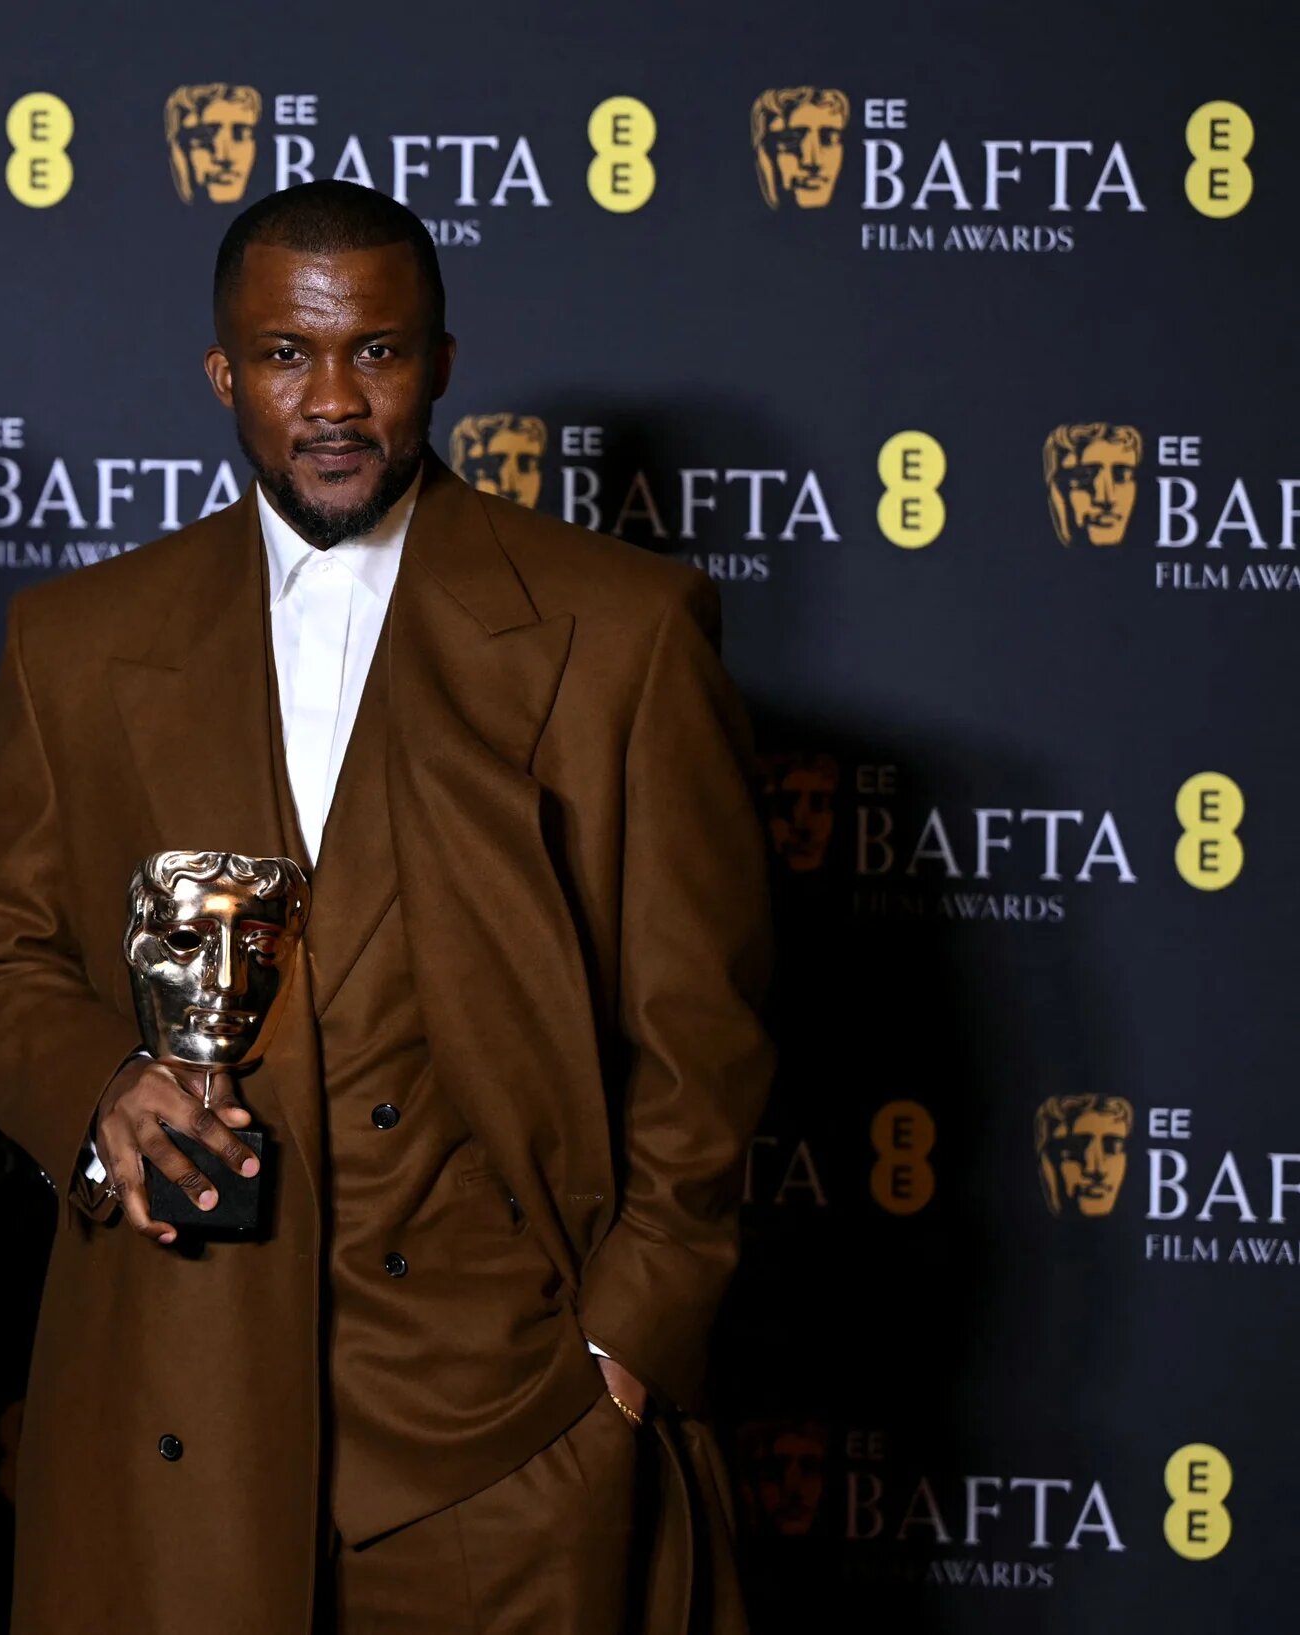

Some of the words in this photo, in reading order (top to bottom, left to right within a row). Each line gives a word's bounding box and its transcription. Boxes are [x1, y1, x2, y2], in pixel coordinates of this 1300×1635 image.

[273, 93, 318, 126] EE
[863, 97, 908, 130] EE
[271, 131, 554, 208] BAFTA
[862, 138, 1146, 213] BAFTA
[860, 223, 935, 251] FILM
[942, 224, 1075, 253] AWARDS
[560, 425, 603, 457] EE
[1157, 434, 1201, 468] EE
[559, 465, 843, 544] BAFTA
[1154, 561, 1230, 590] FILM
[854, 802, 1139, 885] BAFTA
[1147, 1106, 1192, 1140] EE
[1144, 1233, 1219, 1263] FILM
[1227, 1236, 1300, 1266] AWA
[844, 1470, 1128, 1554] BAFTA
[925, 1559, 1056, 1589] AWARDS
